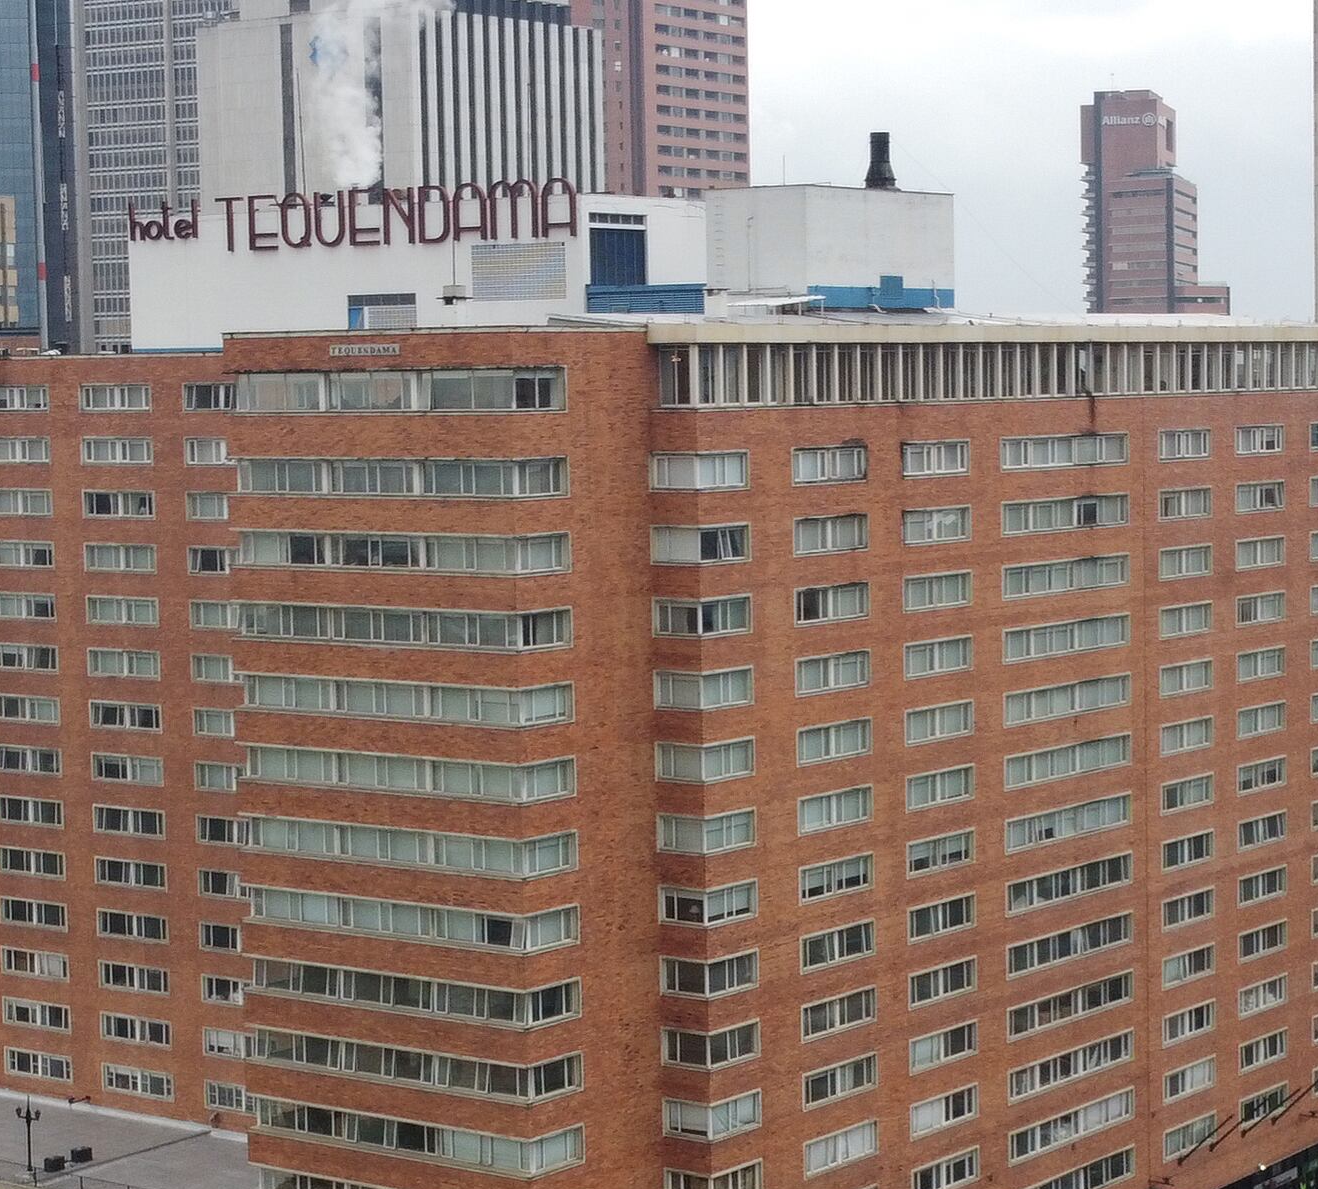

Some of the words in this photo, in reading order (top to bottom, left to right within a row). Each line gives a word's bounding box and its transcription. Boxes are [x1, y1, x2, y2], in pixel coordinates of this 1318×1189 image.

[129, 199, 200, 242] hotel
[214, 177, 578, 253] TEQUENDAMA
[331, 346, 397, 355] TEQUENDAMA
